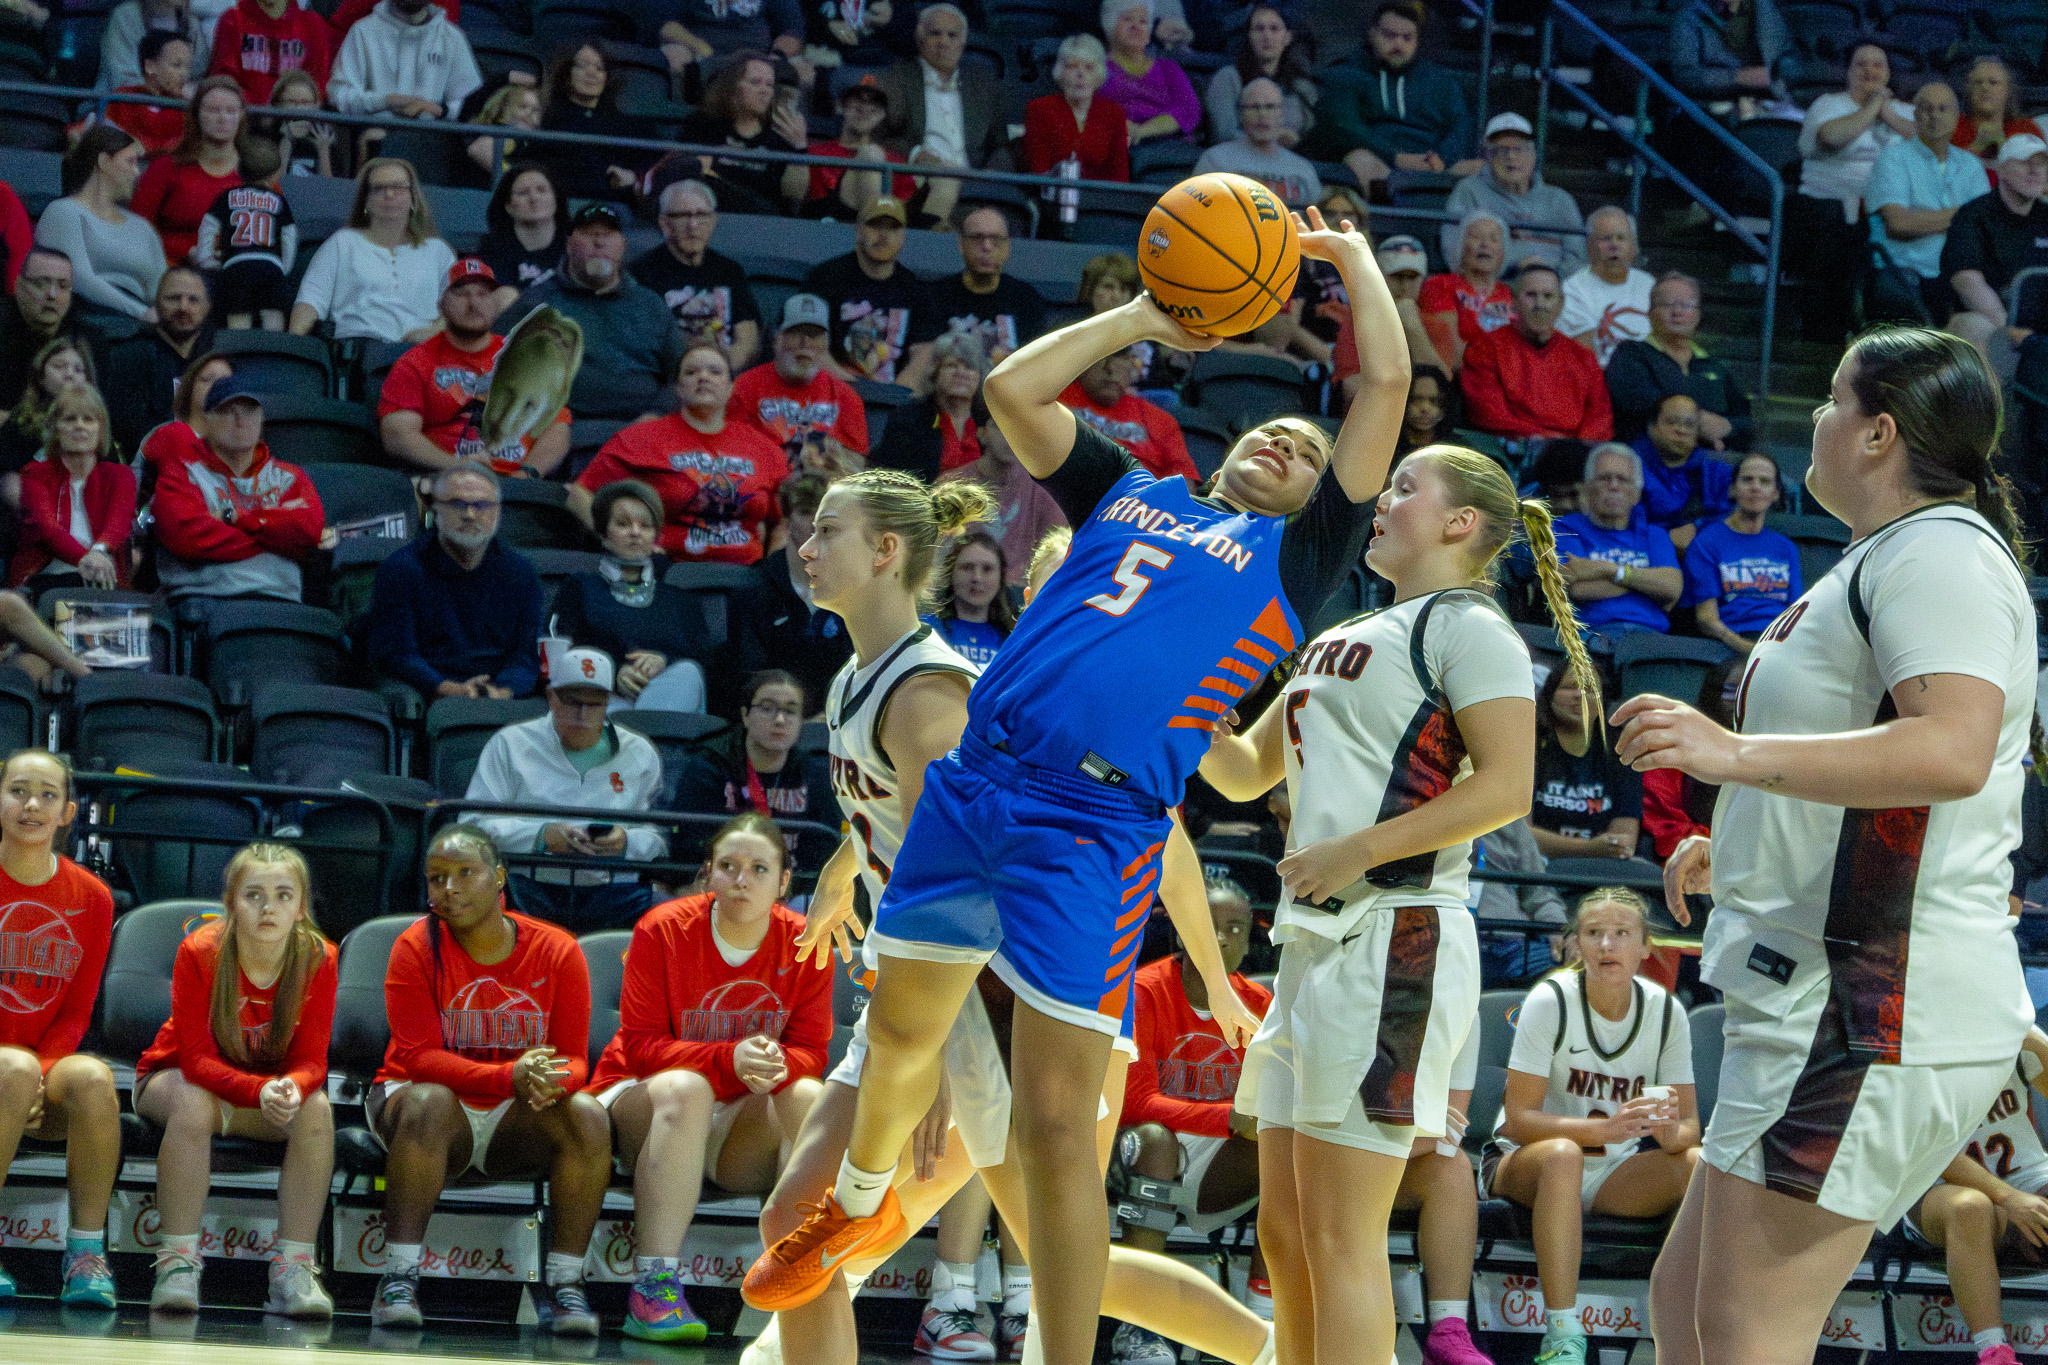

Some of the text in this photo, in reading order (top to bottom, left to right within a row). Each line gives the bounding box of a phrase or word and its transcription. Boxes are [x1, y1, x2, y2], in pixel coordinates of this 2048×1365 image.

[231, 211, 271, 246] 20
[1083, 540, 1175, 618] 5
[1290, 638, 1373, 682] TRO
[1109, 773, 1121, 784] M
[0, 932, 83, 981] ILDCATS
[1566, 1067, 1646, 1103] NITRO
